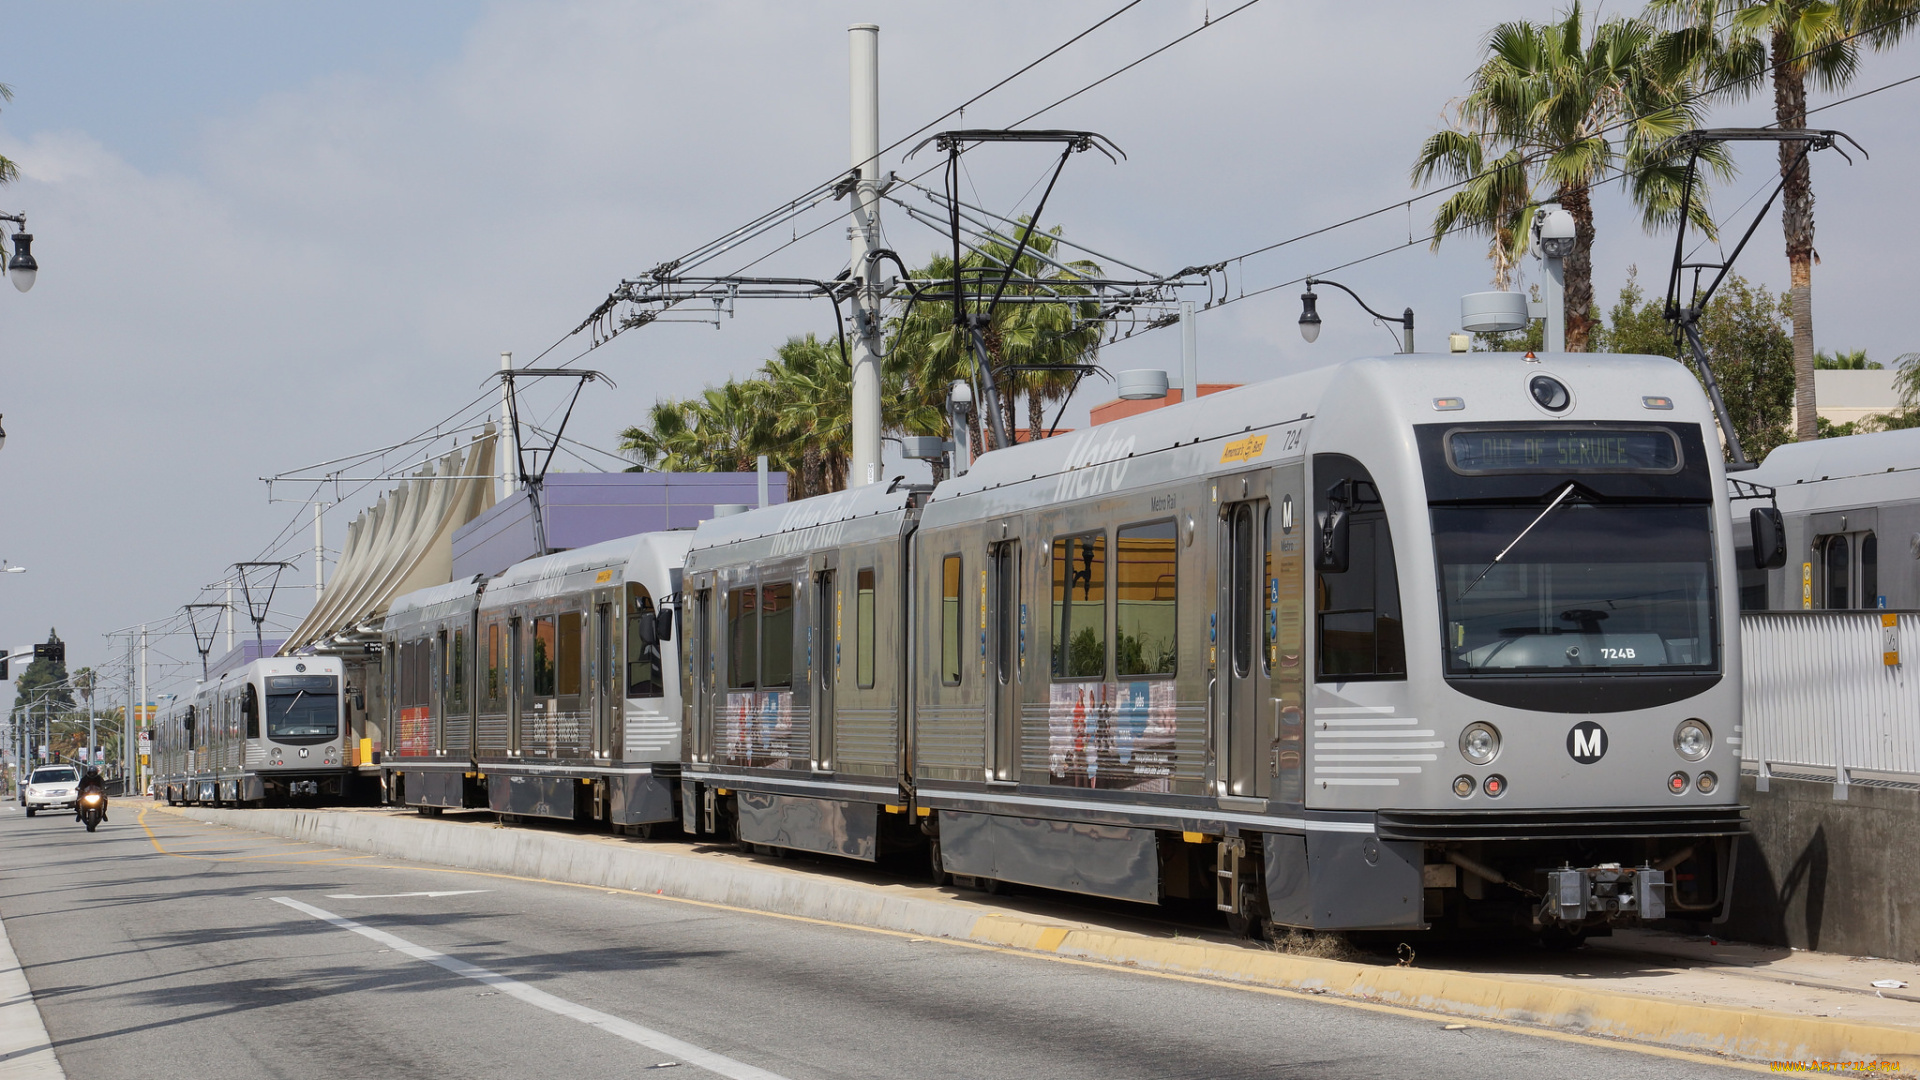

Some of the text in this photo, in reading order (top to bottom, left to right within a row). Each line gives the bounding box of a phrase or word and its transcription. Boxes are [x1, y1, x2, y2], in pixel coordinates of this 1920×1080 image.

[1283, 428, 1302, 451] 724
[1482, 437, 1628, 465] OUT OF SERVICE
[1054, 427, 1136, 502] Metro
[1151, 493, 1177, 512] Metro Rail
[1283, 500, 1292, 528] M
[770, 502, 822, 557] Metro
[1600, 648, 1636, 659] 724B
[1132, 691, 1145, 712] jobs
[299, 749, 308, 757] M
[1574, 728, 1601, 757] M
